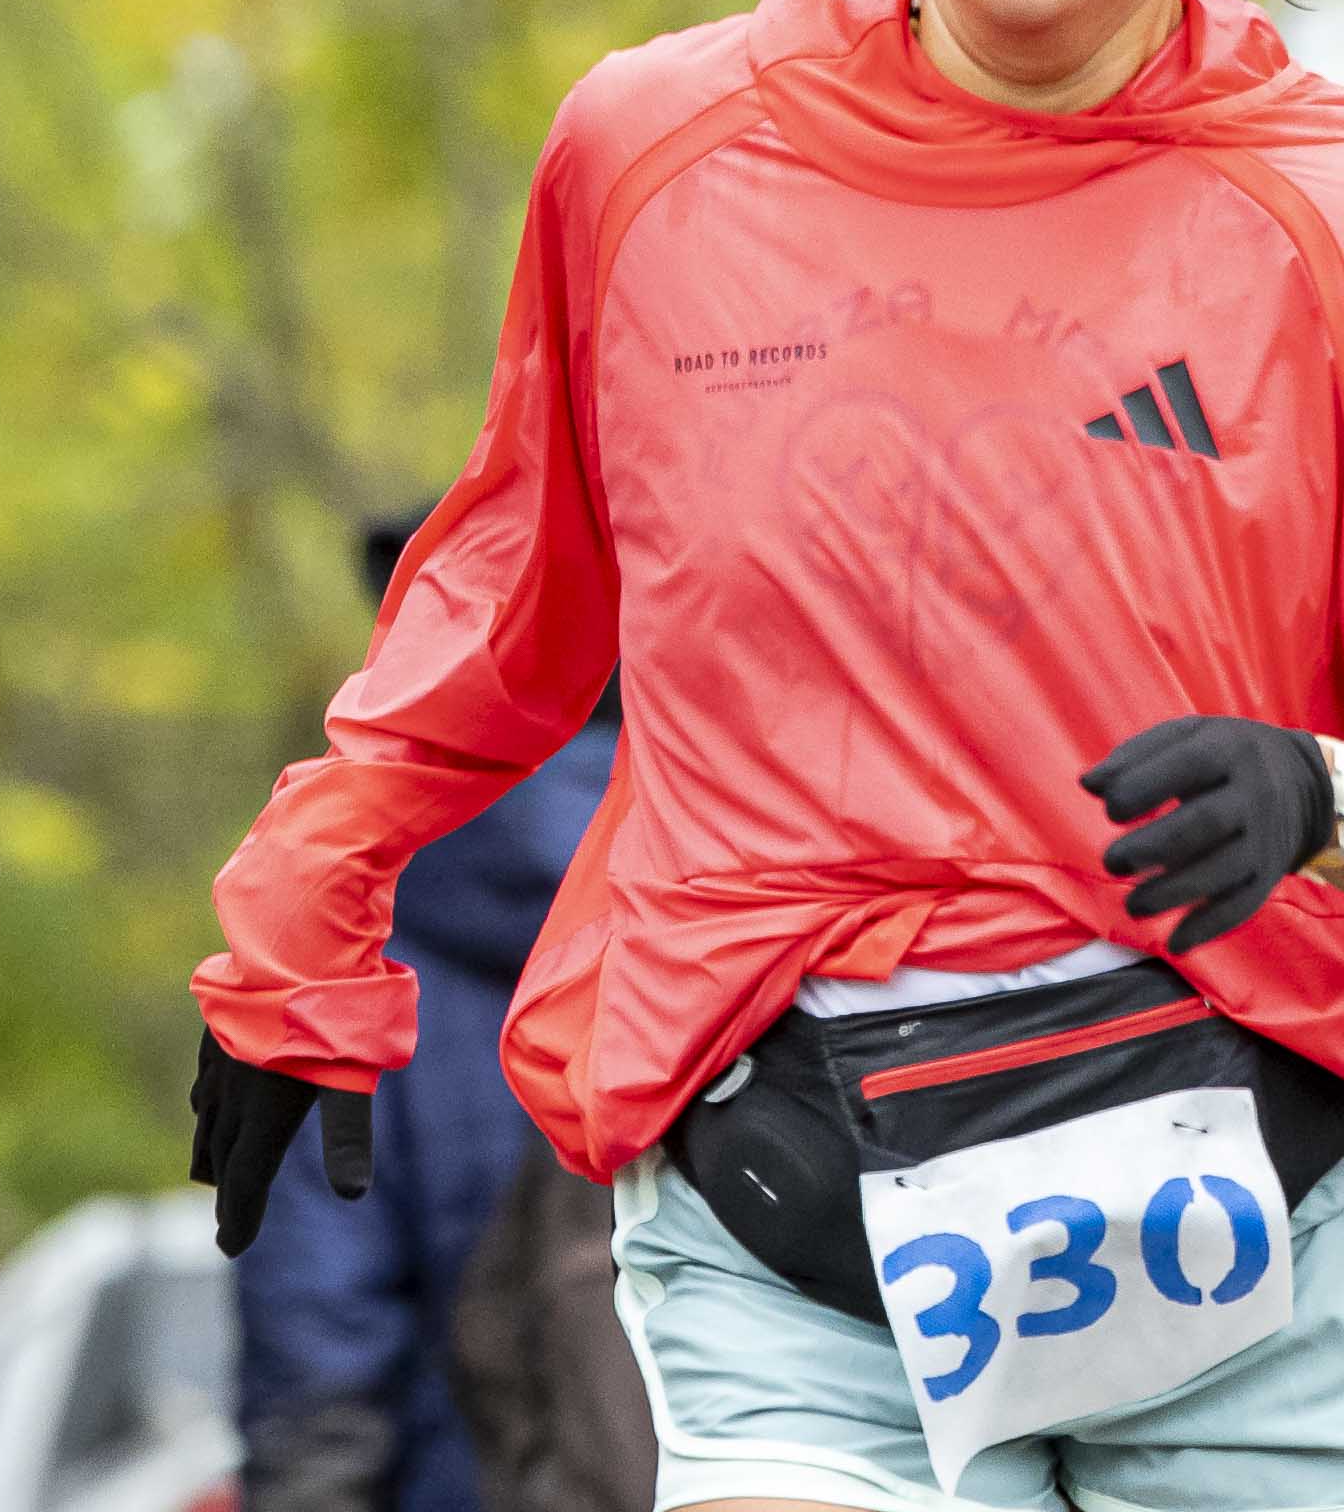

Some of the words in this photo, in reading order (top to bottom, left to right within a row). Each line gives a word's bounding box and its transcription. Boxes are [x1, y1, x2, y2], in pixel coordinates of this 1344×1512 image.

[674, 352, 714, 376] ROAD
[721, 350, 739, 369] TO
[749, 343, 827, 366] RECORDS
[882, 1174, 1270, 1402] 330
